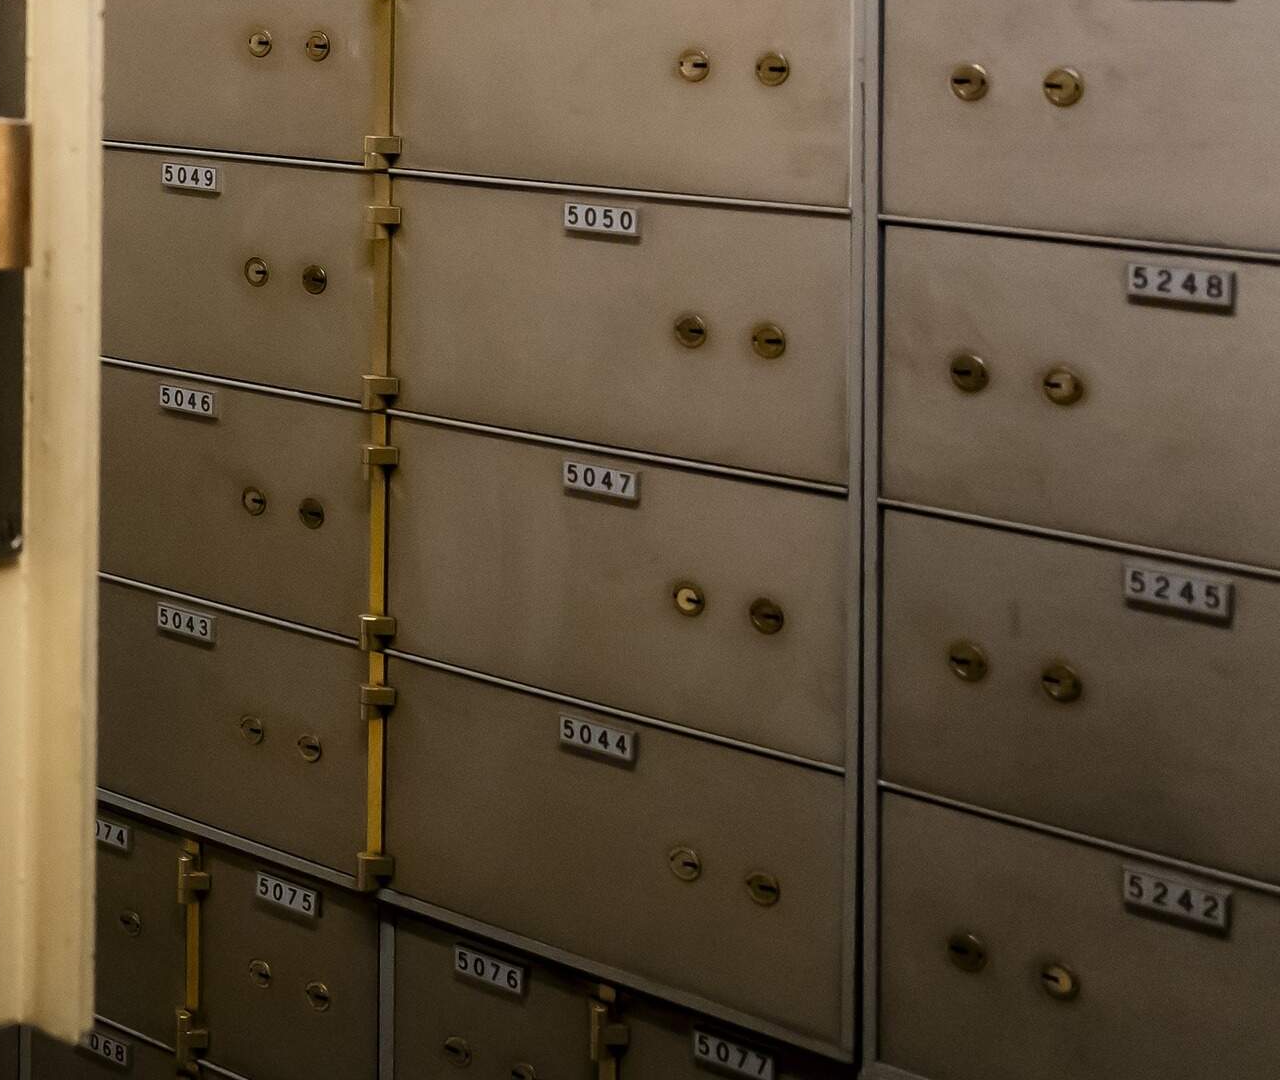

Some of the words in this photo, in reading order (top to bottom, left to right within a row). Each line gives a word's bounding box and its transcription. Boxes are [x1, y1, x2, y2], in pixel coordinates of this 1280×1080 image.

[165, 165, 214, 186] 5049
[568, 206, 632, 230] 5050
[1133, 266, 1223, 298] 5248
[162, 388, 210, 412] 5046
[567, 464, 631, 494] 5047
[1130, 571, 1220, 608] 5245
[159, 608, 208, 637] 5043
[563, 719, 627, 754] 5044
[259, 876, 313, 911] 5075
[1129, 876, 1218, 919] 5242
[458, 951, 518, 989] 5076
[91, 1035, 123, 1061] 068
[699, 1035, 767, 1075] 5077
